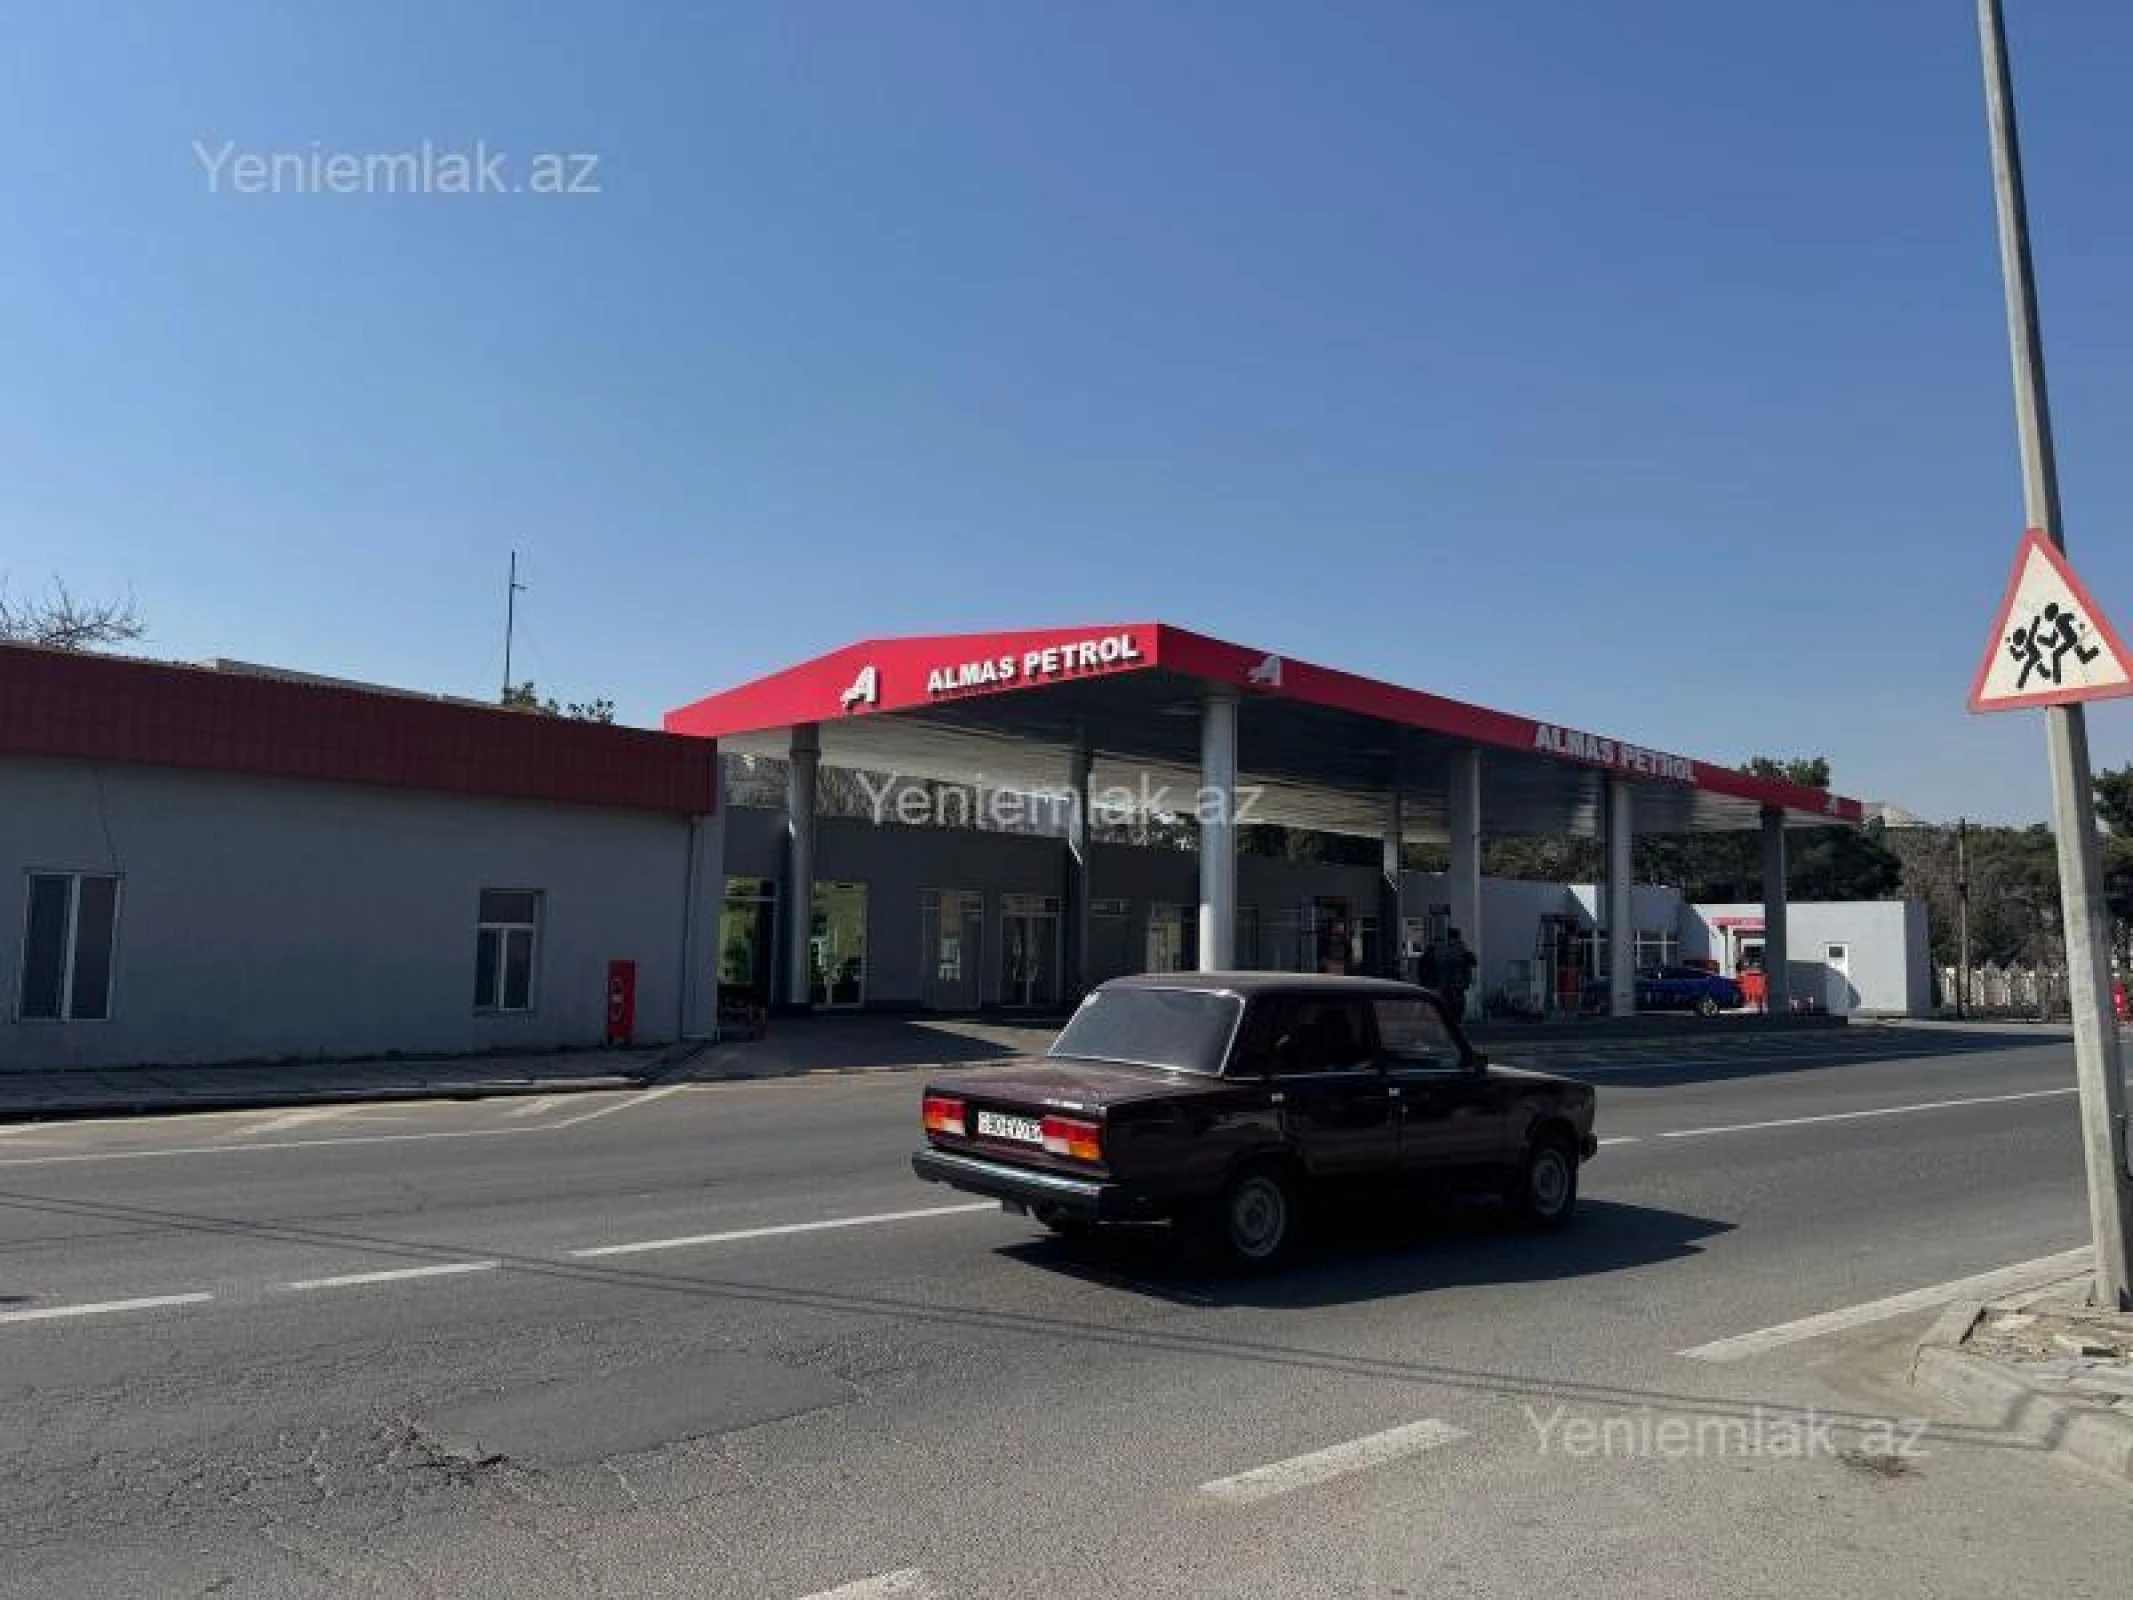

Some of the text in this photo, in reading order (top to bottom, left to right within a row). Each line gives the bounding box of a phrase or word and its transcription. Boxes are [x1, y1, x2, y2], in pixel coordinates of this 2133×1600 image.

[927, 634, 1138, 692] ALMAS PETROL
[1535, 724, 1697, 782] ALMAS PETROL
